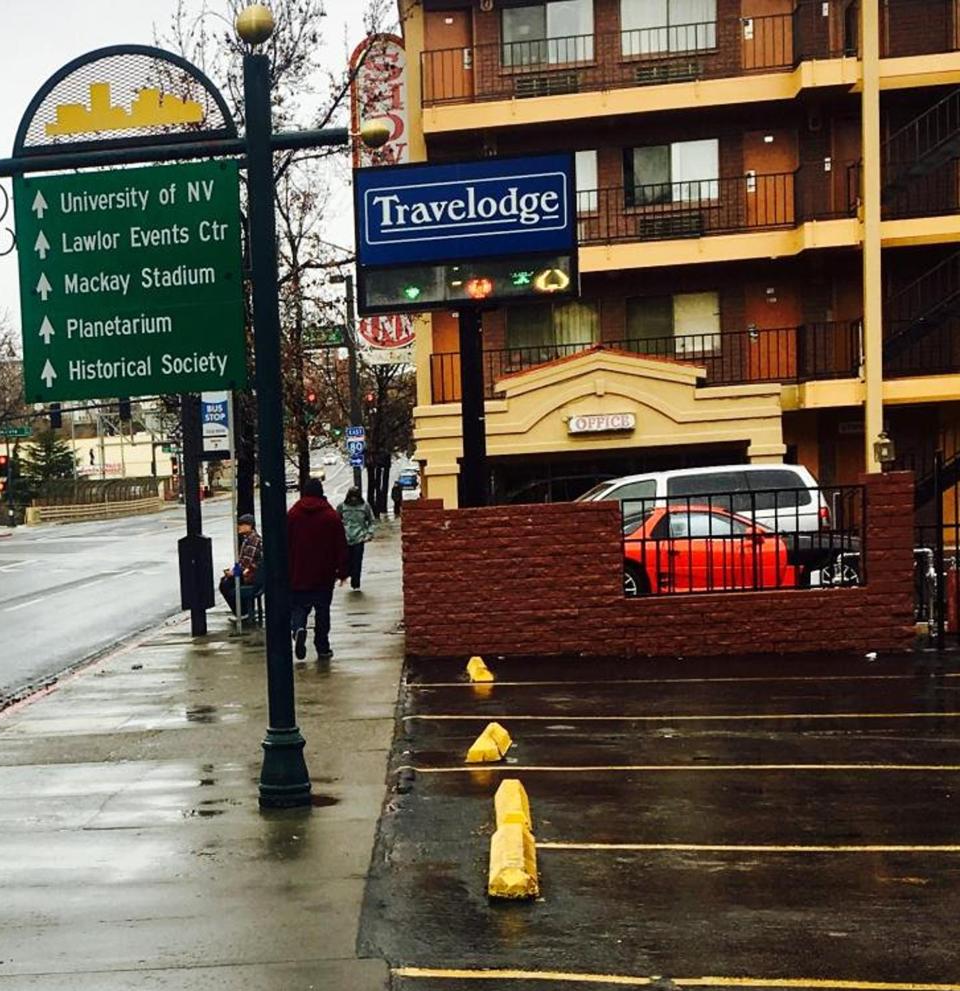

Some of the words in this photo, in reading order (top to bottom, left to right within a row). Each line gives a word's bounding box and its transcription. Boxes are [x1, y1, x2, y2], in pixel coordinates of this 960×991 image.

[60, 186, 150, 213] University
[159, 183, 176, 205] of
[188, 179, 214, 203] NV
[372, 186, 560, 225] Travelodge
[62, 230, 120, 253] Lawlor
[130, 223, 190, 247] Events
[199, 220, 229, 242] Ctr
[64, 271, 131, 295] Mackay
[141, 264, 216, 289] Stadium
[66, 313, 172, 339] Planetarium
[68, 356, 152, 381] Historical
[161, 352, 228, 376] Society
[204, 413, 226, 421] STOP
[206, 404, 224, 413] BUS
[575, 415, 630, 430] OFFICE
[350, 442, 363, 453] 80
